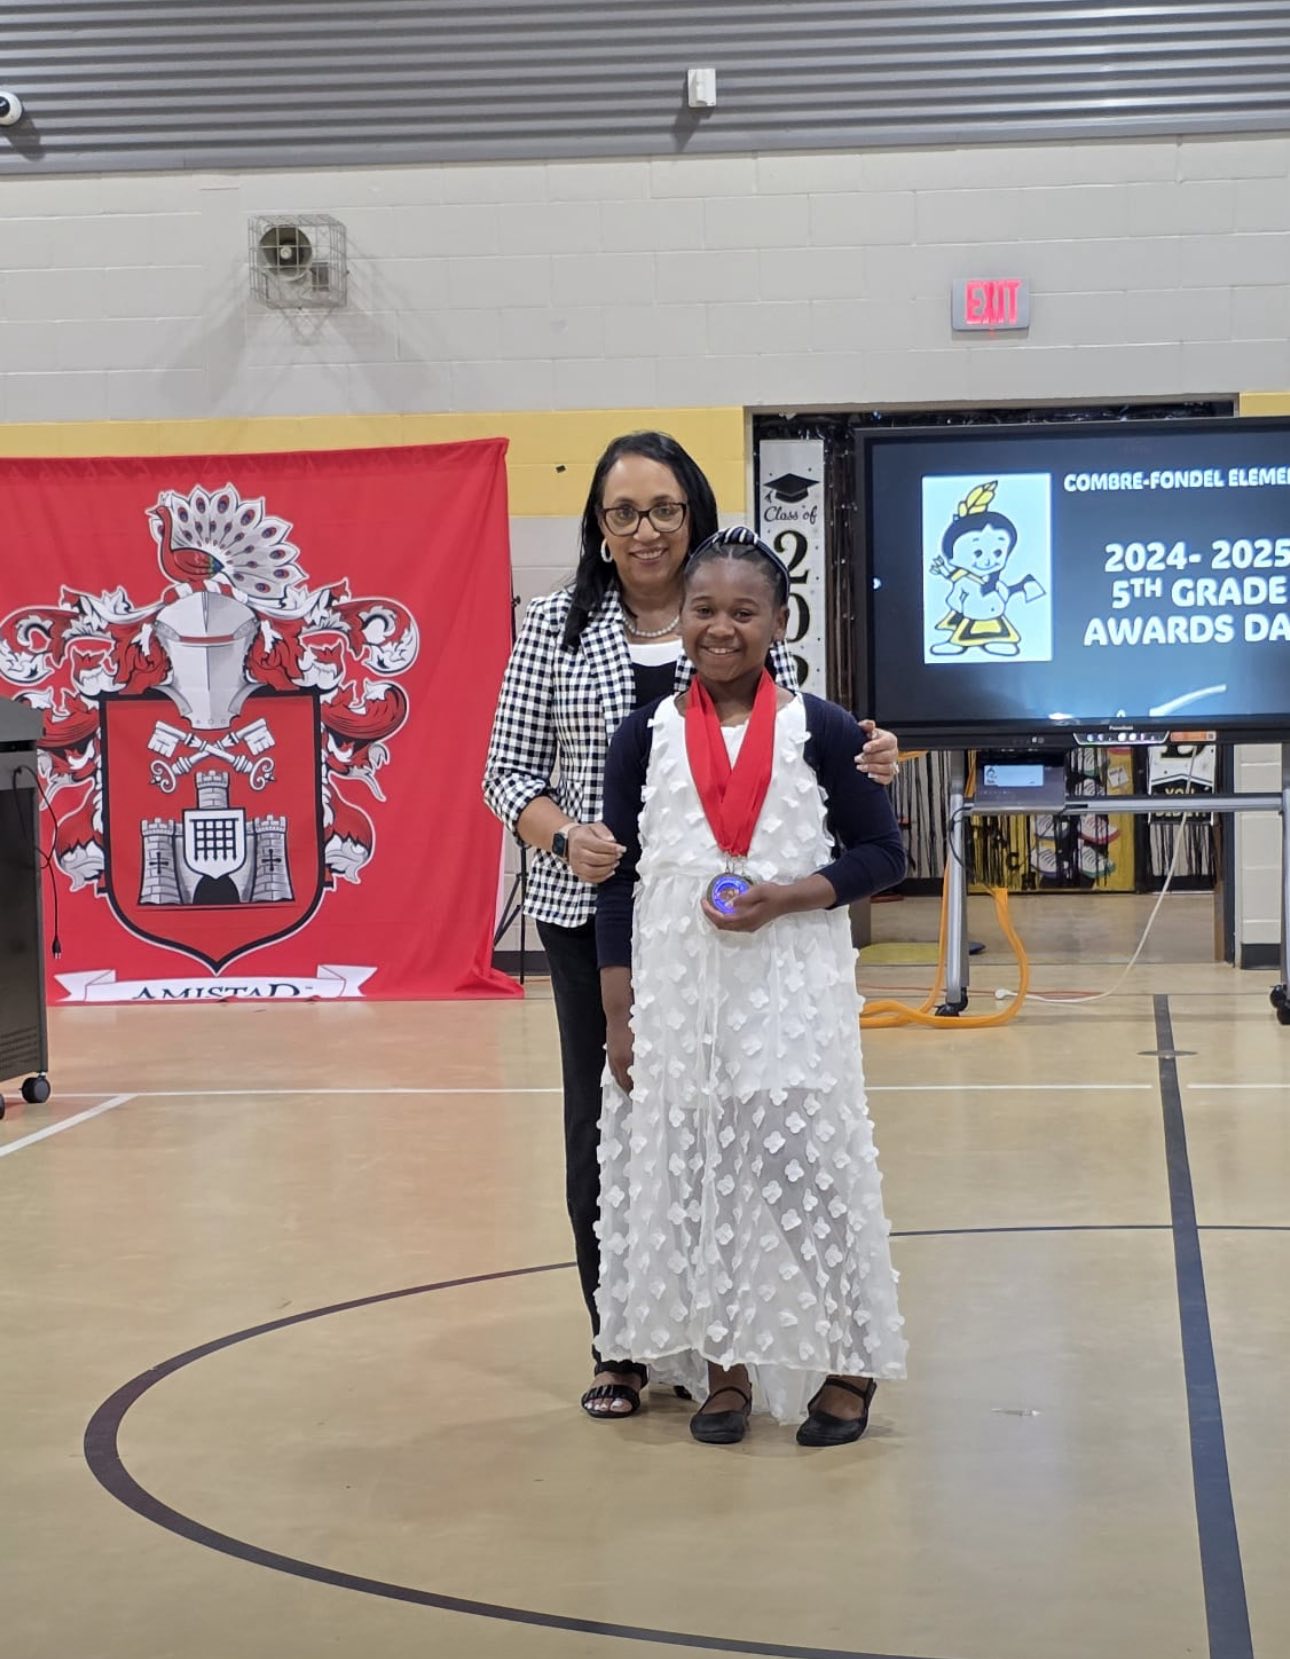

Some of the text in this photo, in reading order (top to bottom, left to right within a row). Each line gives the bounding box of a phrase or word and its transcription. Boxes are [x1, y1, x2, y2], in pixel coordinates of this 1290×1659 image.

[965, 279, 1022, 325] EXIT
[1064, 470, 1224, 491] COMBRE-FONDEL
[763, 505, 818, 524] Class of
[1105, 538, 1290, 572] 2024- 2025
[1112, 576, 1288, 609] 5TH GRADE
[1084, 612, 1290, 646] AWARDS DA
